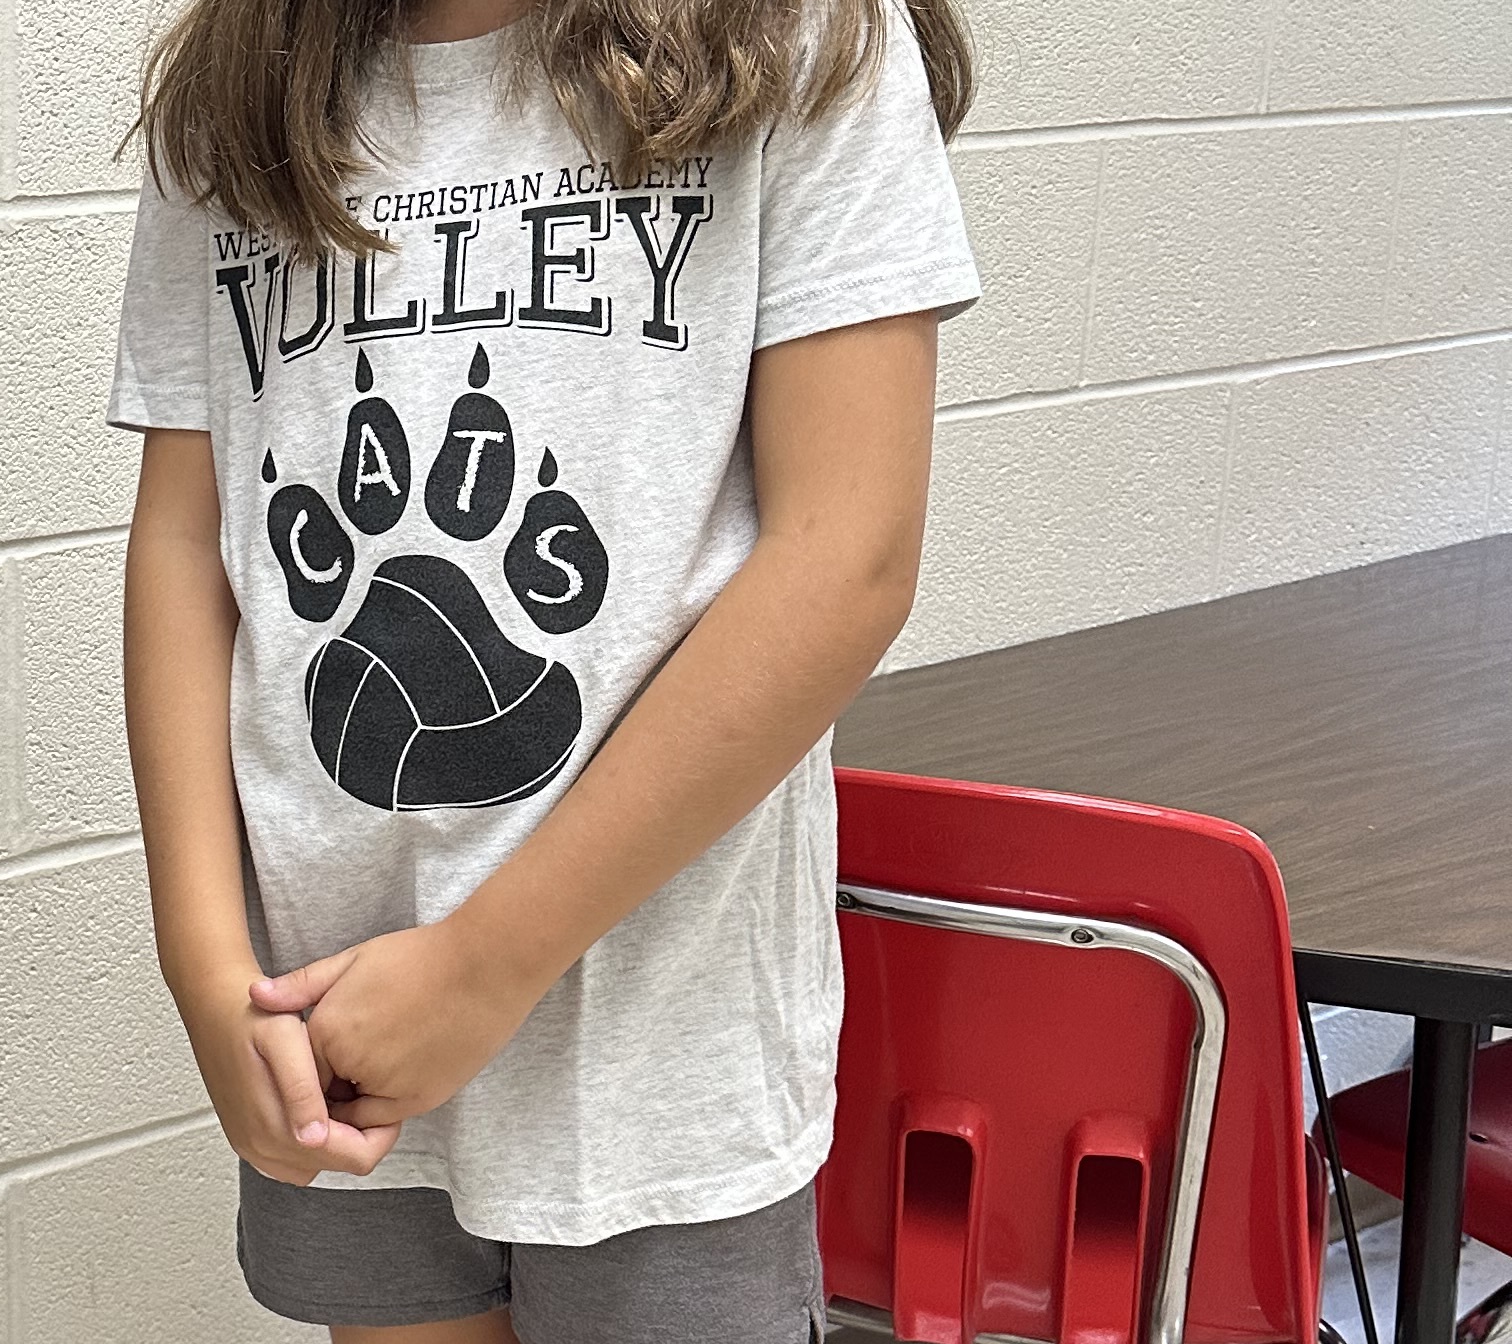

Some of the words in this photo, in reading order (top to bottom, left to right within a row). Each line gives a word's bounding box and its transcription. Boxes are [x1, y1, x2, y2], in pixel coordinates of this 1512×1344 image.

[214, 227, 278, 262] WES
[373, 172, 544, 223] CHRISTIAN
[215, 194, 714, 403] VOLLEY
